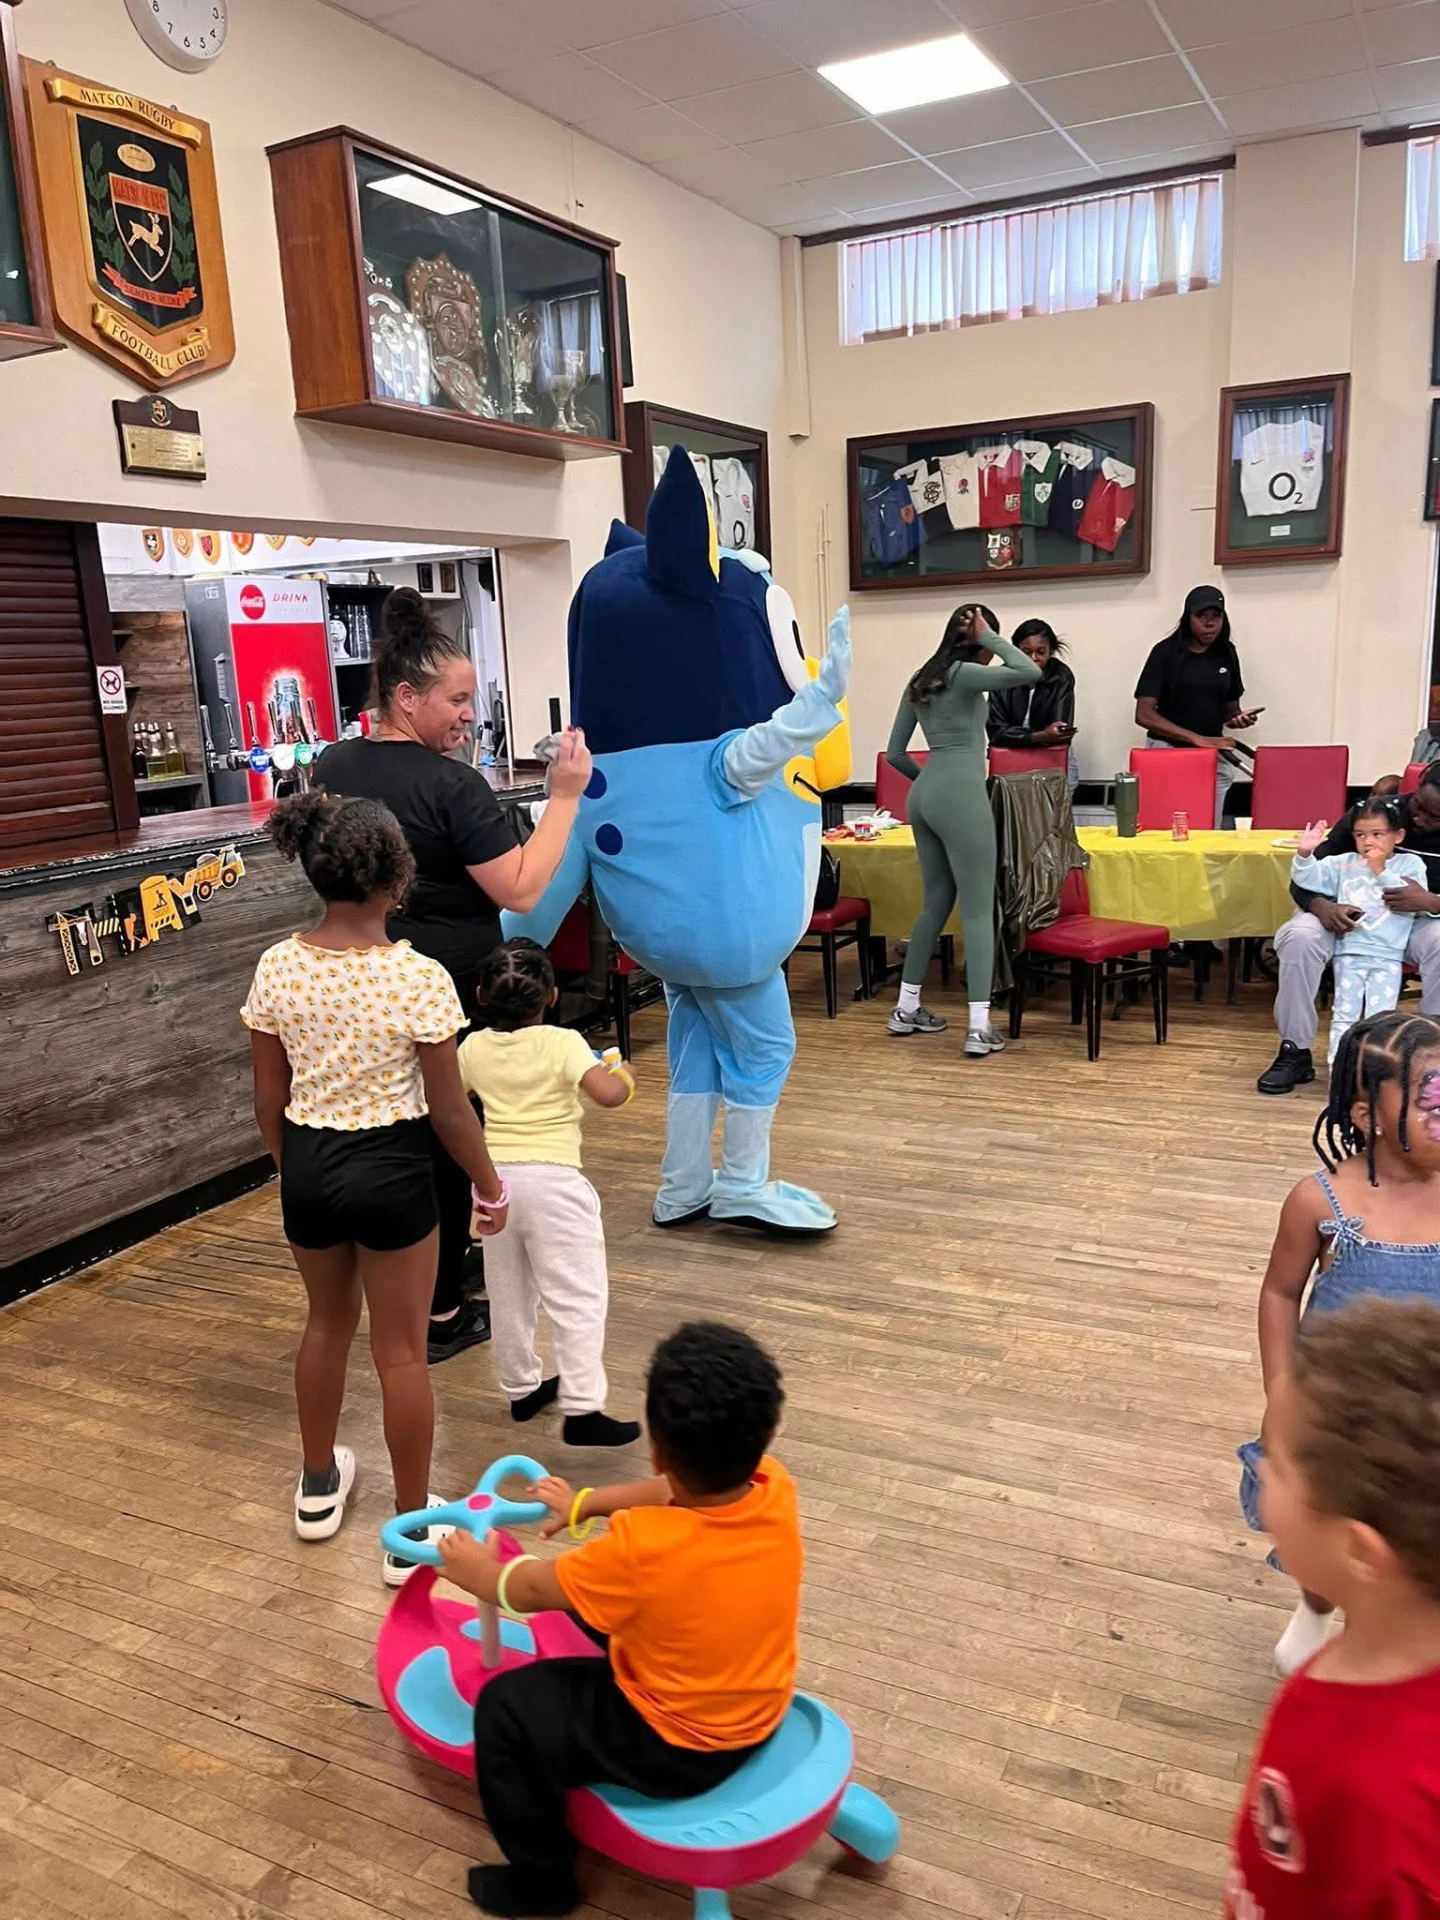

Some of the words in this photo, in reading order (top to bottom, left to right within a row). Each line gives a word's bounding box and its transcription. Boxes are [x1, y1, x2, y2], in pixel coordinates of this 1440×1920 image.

[212, 7, 219, 20] 3
[167, 21, 173, 34] 7
[209, 28, 217, 39] 4
[183, 36, 191, 48] 6
[199, 37, 206, 49] 5
[80, 89, 133, 108] MATSON
[138, 100, 176, 131] RUGBY
[111, 324, 173, 371] FOOTBALL
[176, 344, 205, 366] CLUB
[1268, 472, 1303, 505] O2
[272, 593, 309, 602] DRINK
